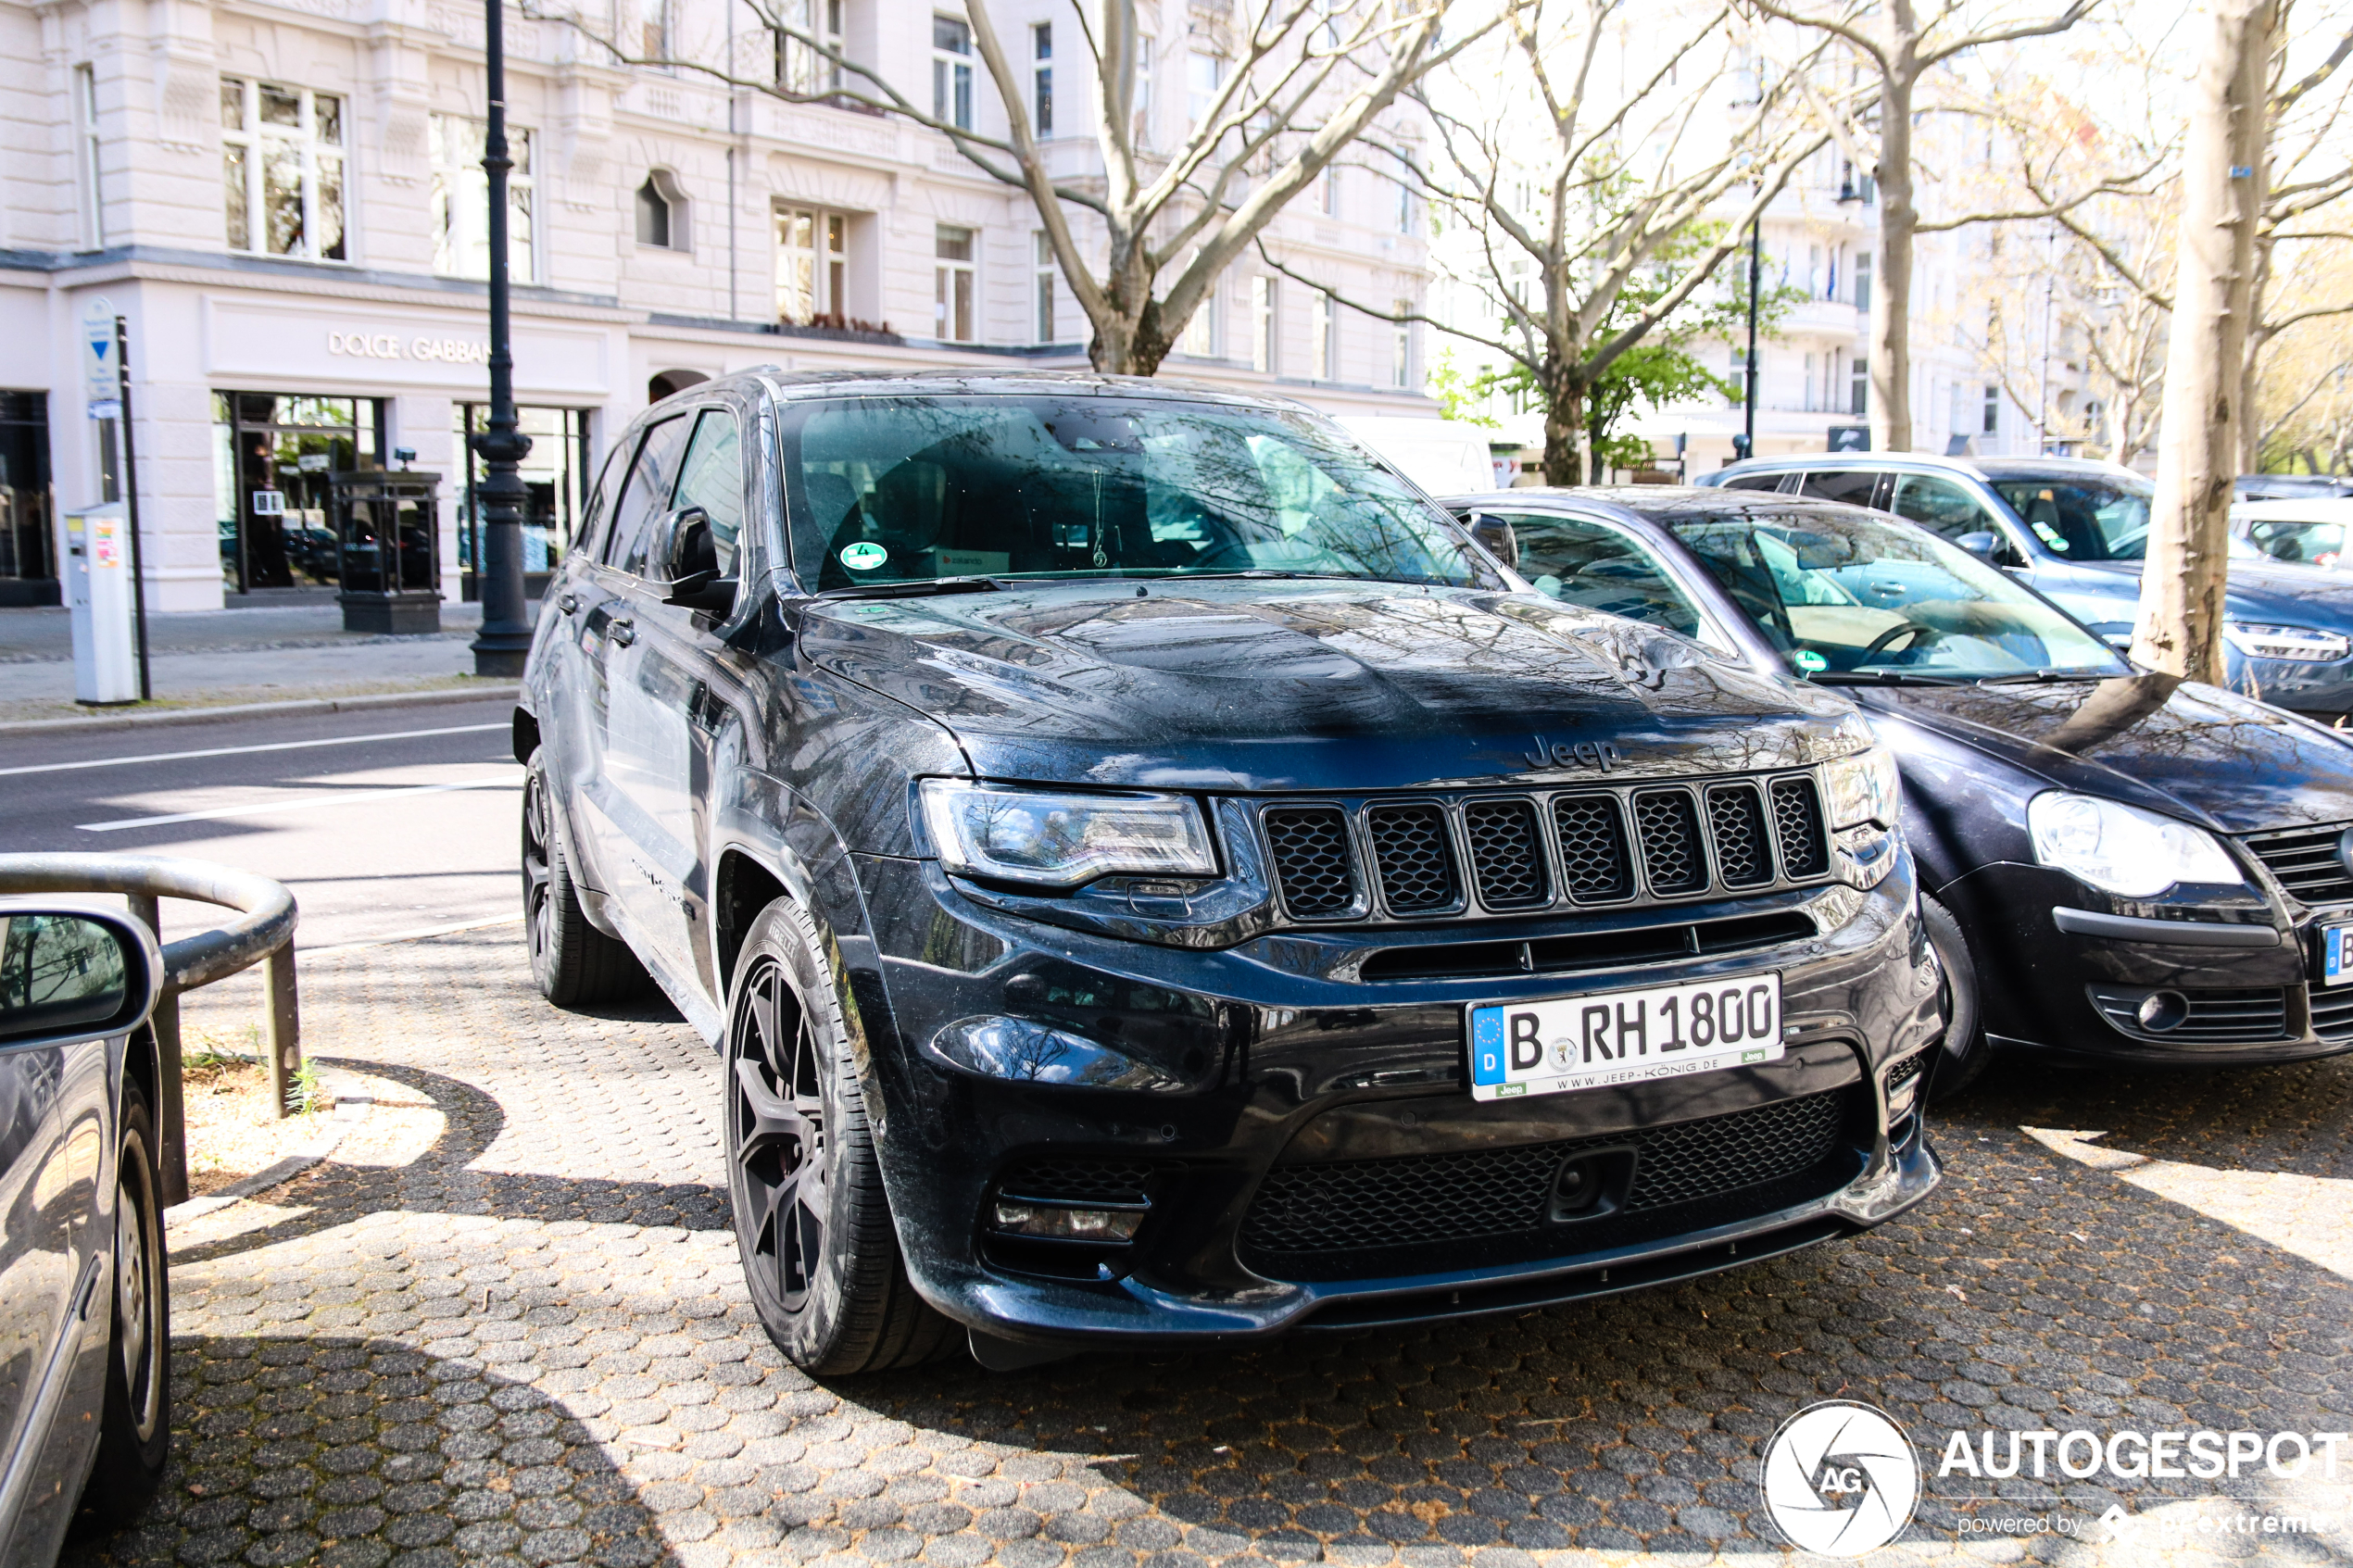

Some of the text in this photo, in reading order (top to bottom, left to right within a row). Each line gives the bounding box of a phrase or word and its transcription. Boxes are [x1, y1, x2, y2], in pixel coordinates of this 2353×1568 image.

[328, 331, 492, 365] DOLCE & GABBAN
[857, 545, 869, 556] 4
[1525, 735, 1620, 772] Jeep
[1510, 984, 1771, 1071] B RH 1800
[1484, 1053, 1496, 1071] D
[1744, 1051, 1764, 1061] Jeep
[1557, 1059, 1718, 1089] WWW.JEEP-KÖNIG.DE
[1500, 1085, 1523, 1096] Jeep
